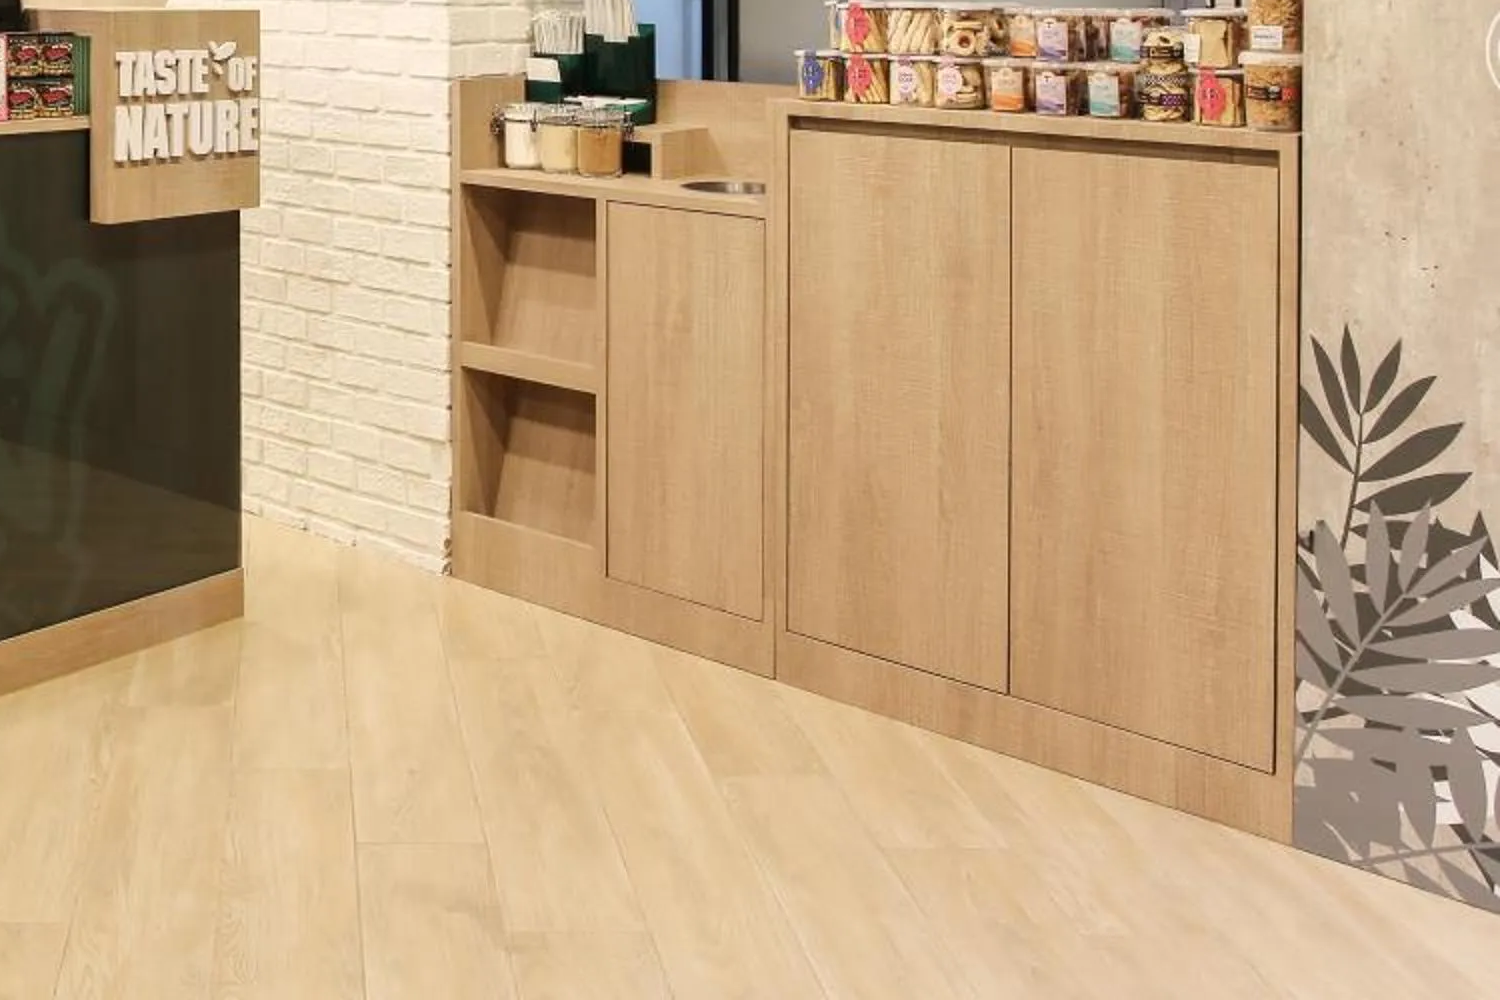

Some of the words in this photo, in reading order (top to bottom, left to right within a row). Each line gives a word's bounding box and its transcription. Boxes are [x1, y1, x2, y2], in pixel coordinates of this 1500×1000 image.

[115, 49, 209, 98] TASTE
[228, 56, 257, 92] OF
[115, 99, 259, 163] NATURE
